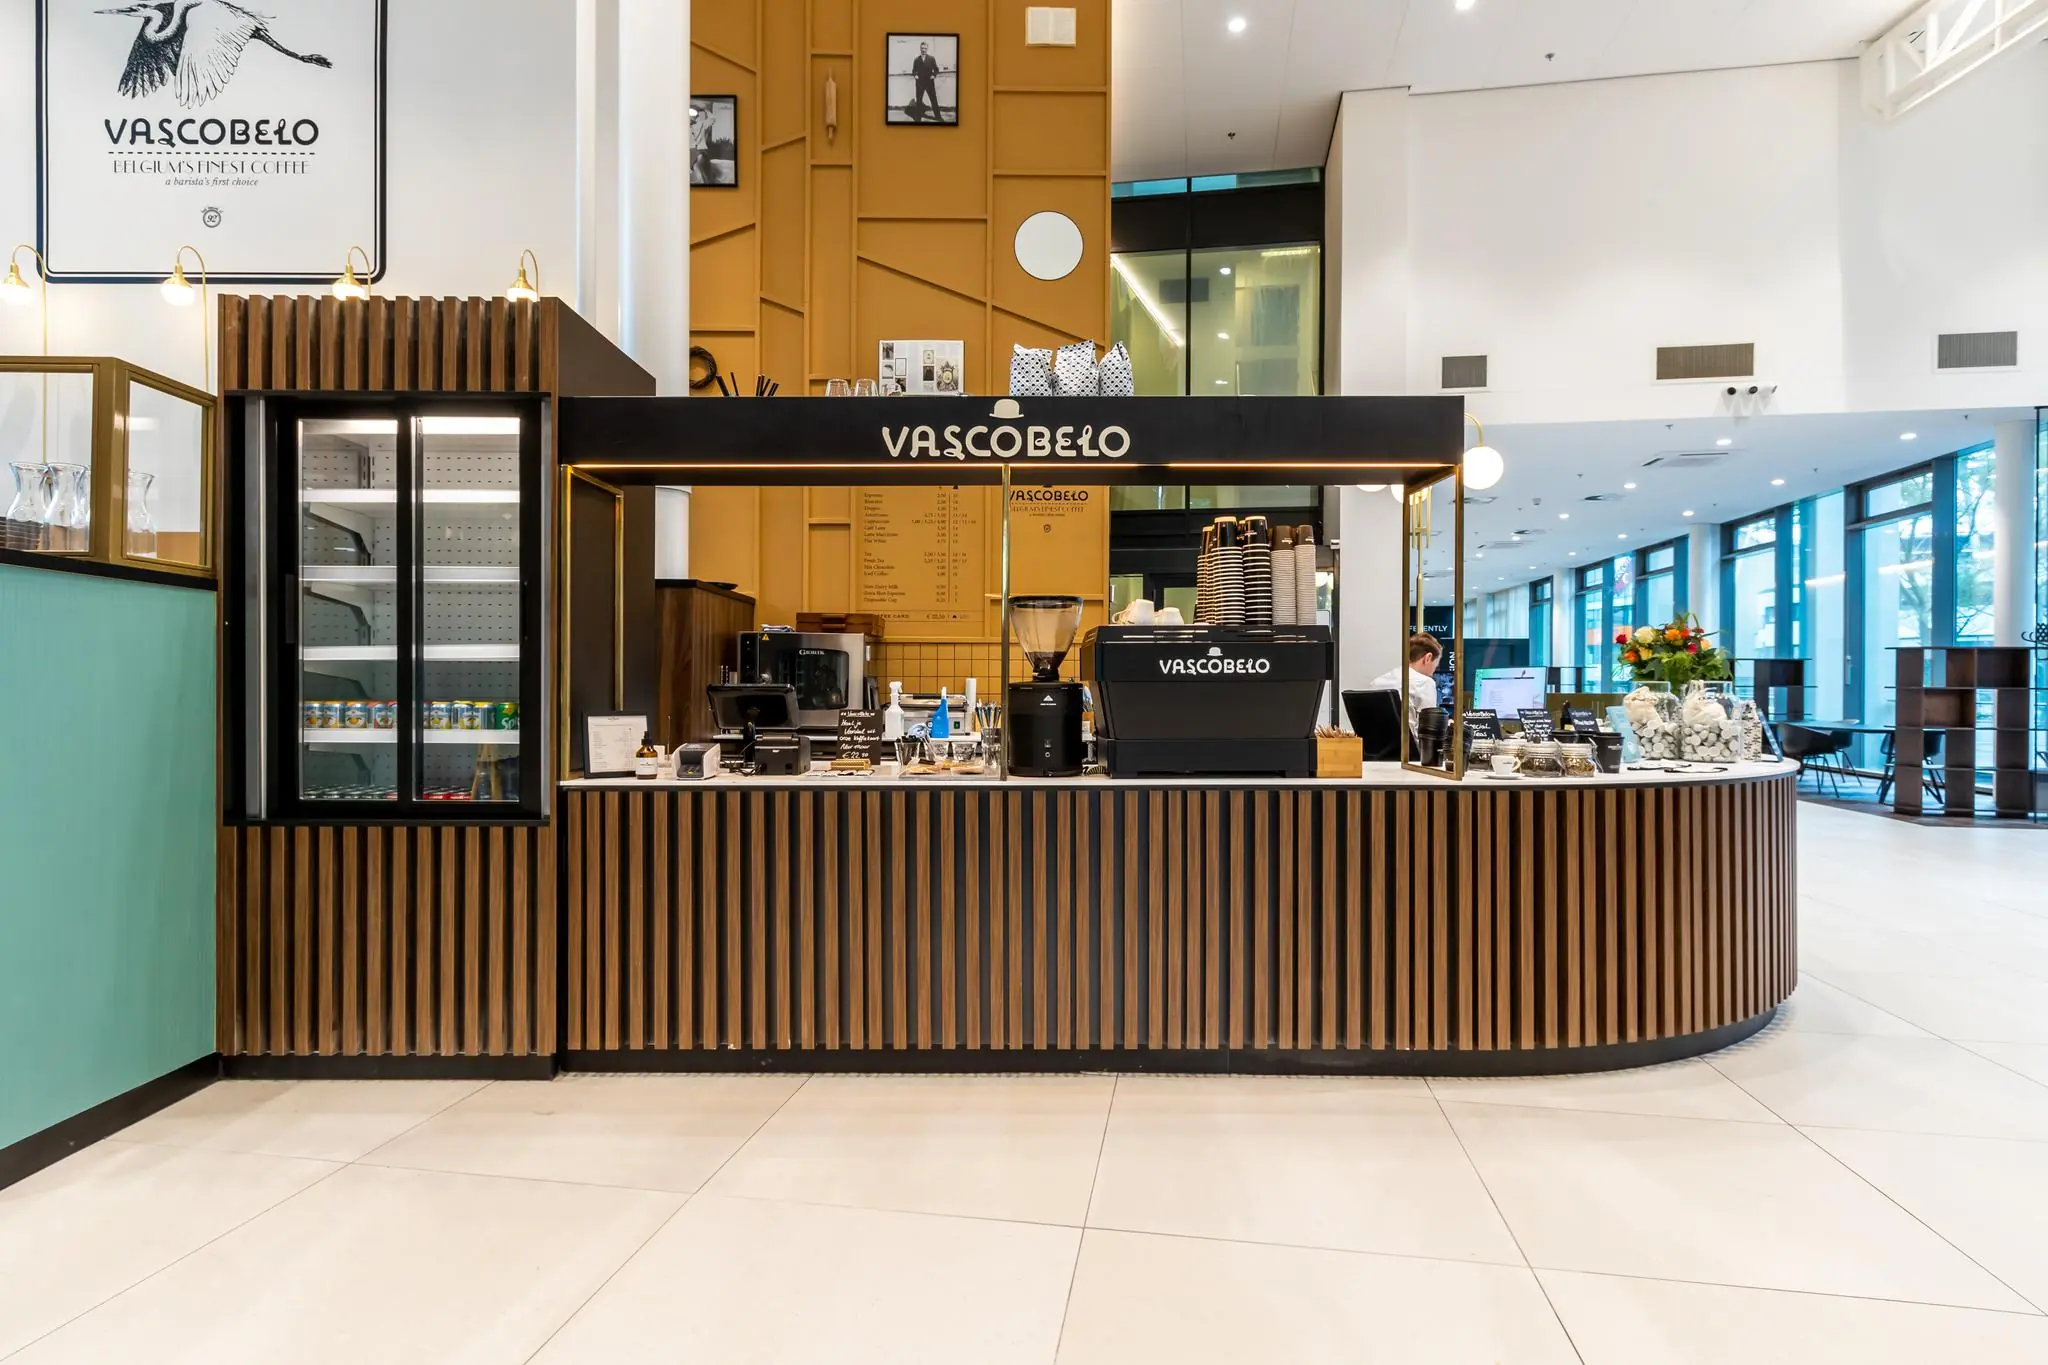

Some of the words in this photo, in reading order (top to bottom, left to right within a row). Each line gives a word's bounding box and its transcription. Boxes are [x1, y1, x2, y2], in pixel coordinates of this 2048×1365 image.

[104, 117, 319, 148] VASCOBELO
[113, 160, 194, 174] BELGIUM'S
[198, 160, 246, 174] FINEST
[251, 160, 309, 174] COFFEE
[173, 177, 210, 186] barista's
[212, 177, 230, 187] first
[232, 177, 259, 186] choice
[881, 424, 1131, 461] VASCOBELO
[1158, 658, 1271, 676] VASCOBELO
